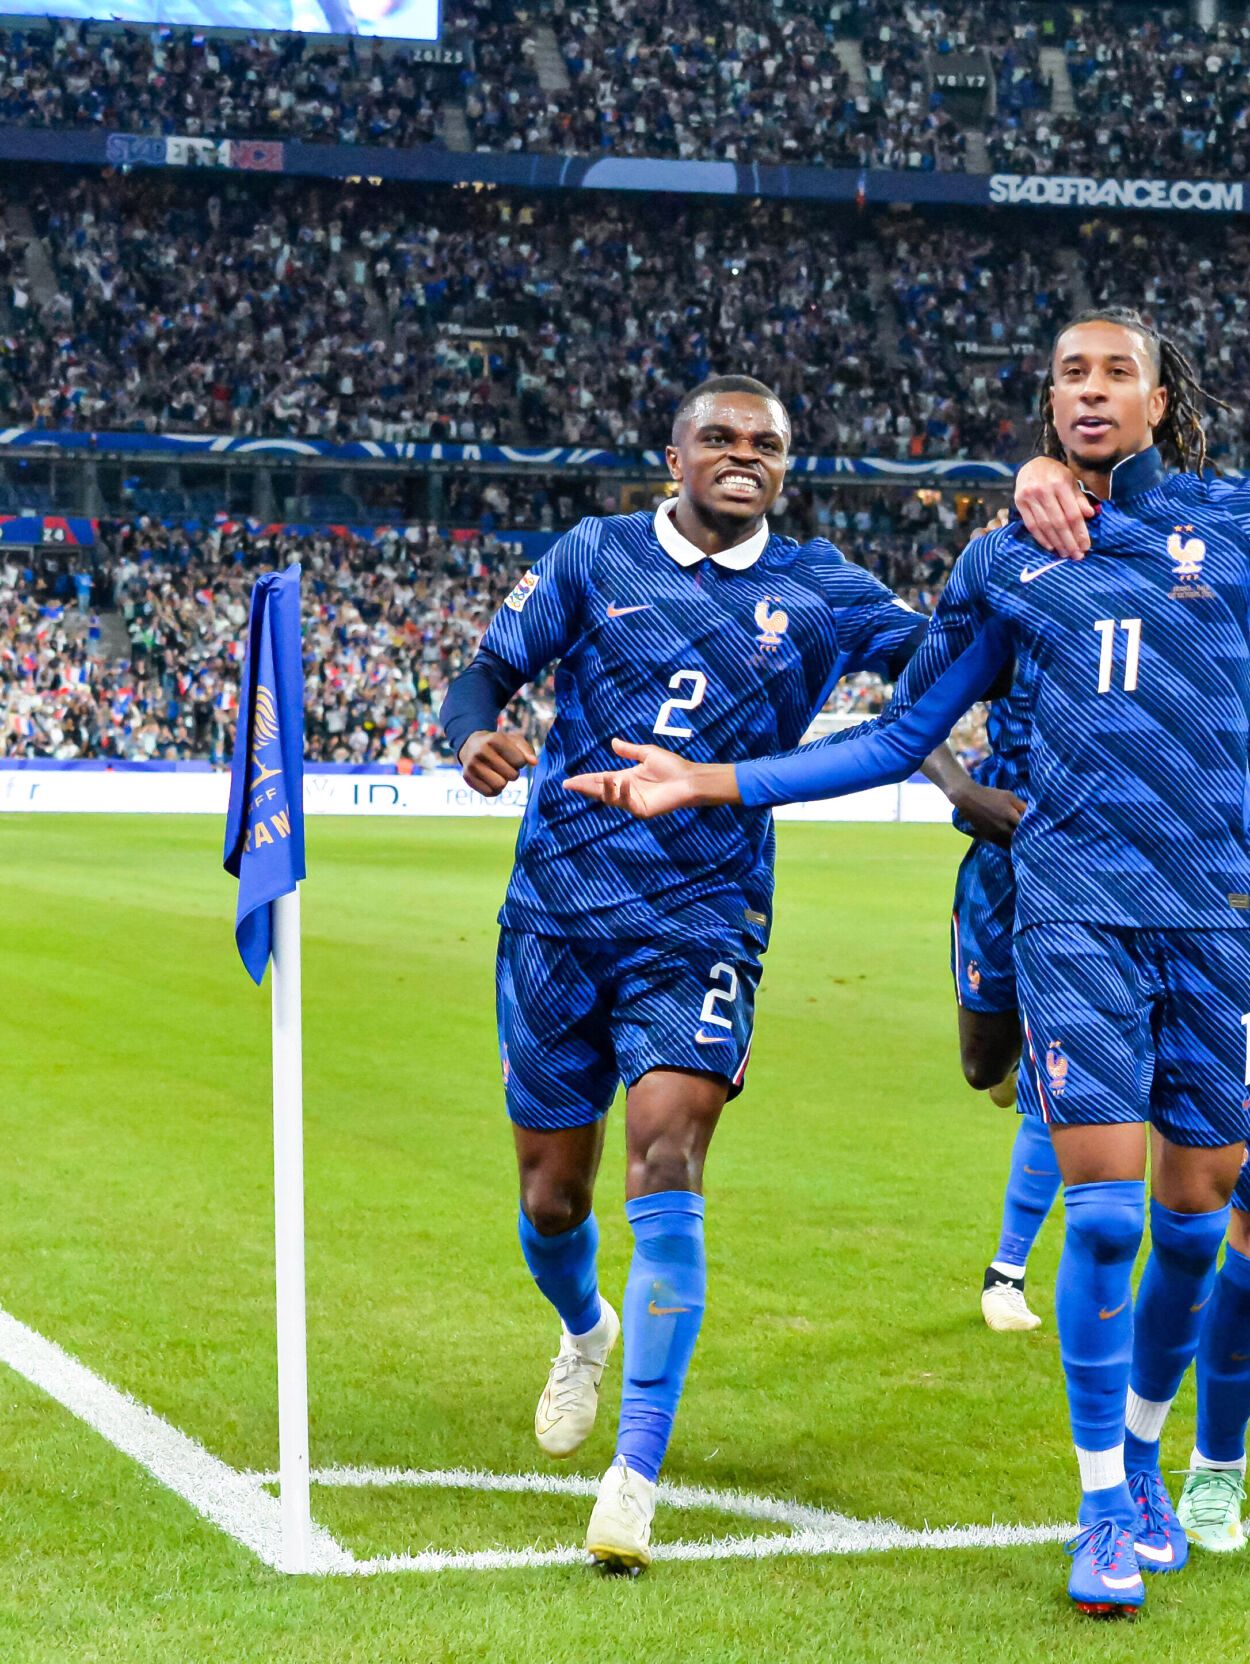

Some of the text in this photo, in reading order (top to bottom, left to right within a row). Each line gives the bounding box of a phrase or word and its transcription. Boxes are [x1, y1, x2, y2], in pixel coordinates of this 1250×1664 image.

[936, 75, 985, 87] Y8 Y7
[990, 174, 1243, 210] STADEFRANCE.COM
[1094, 618, 1142, 694] 11
[653, 669, 708, 738] 2
[700, 961, 738, 1030] 2
